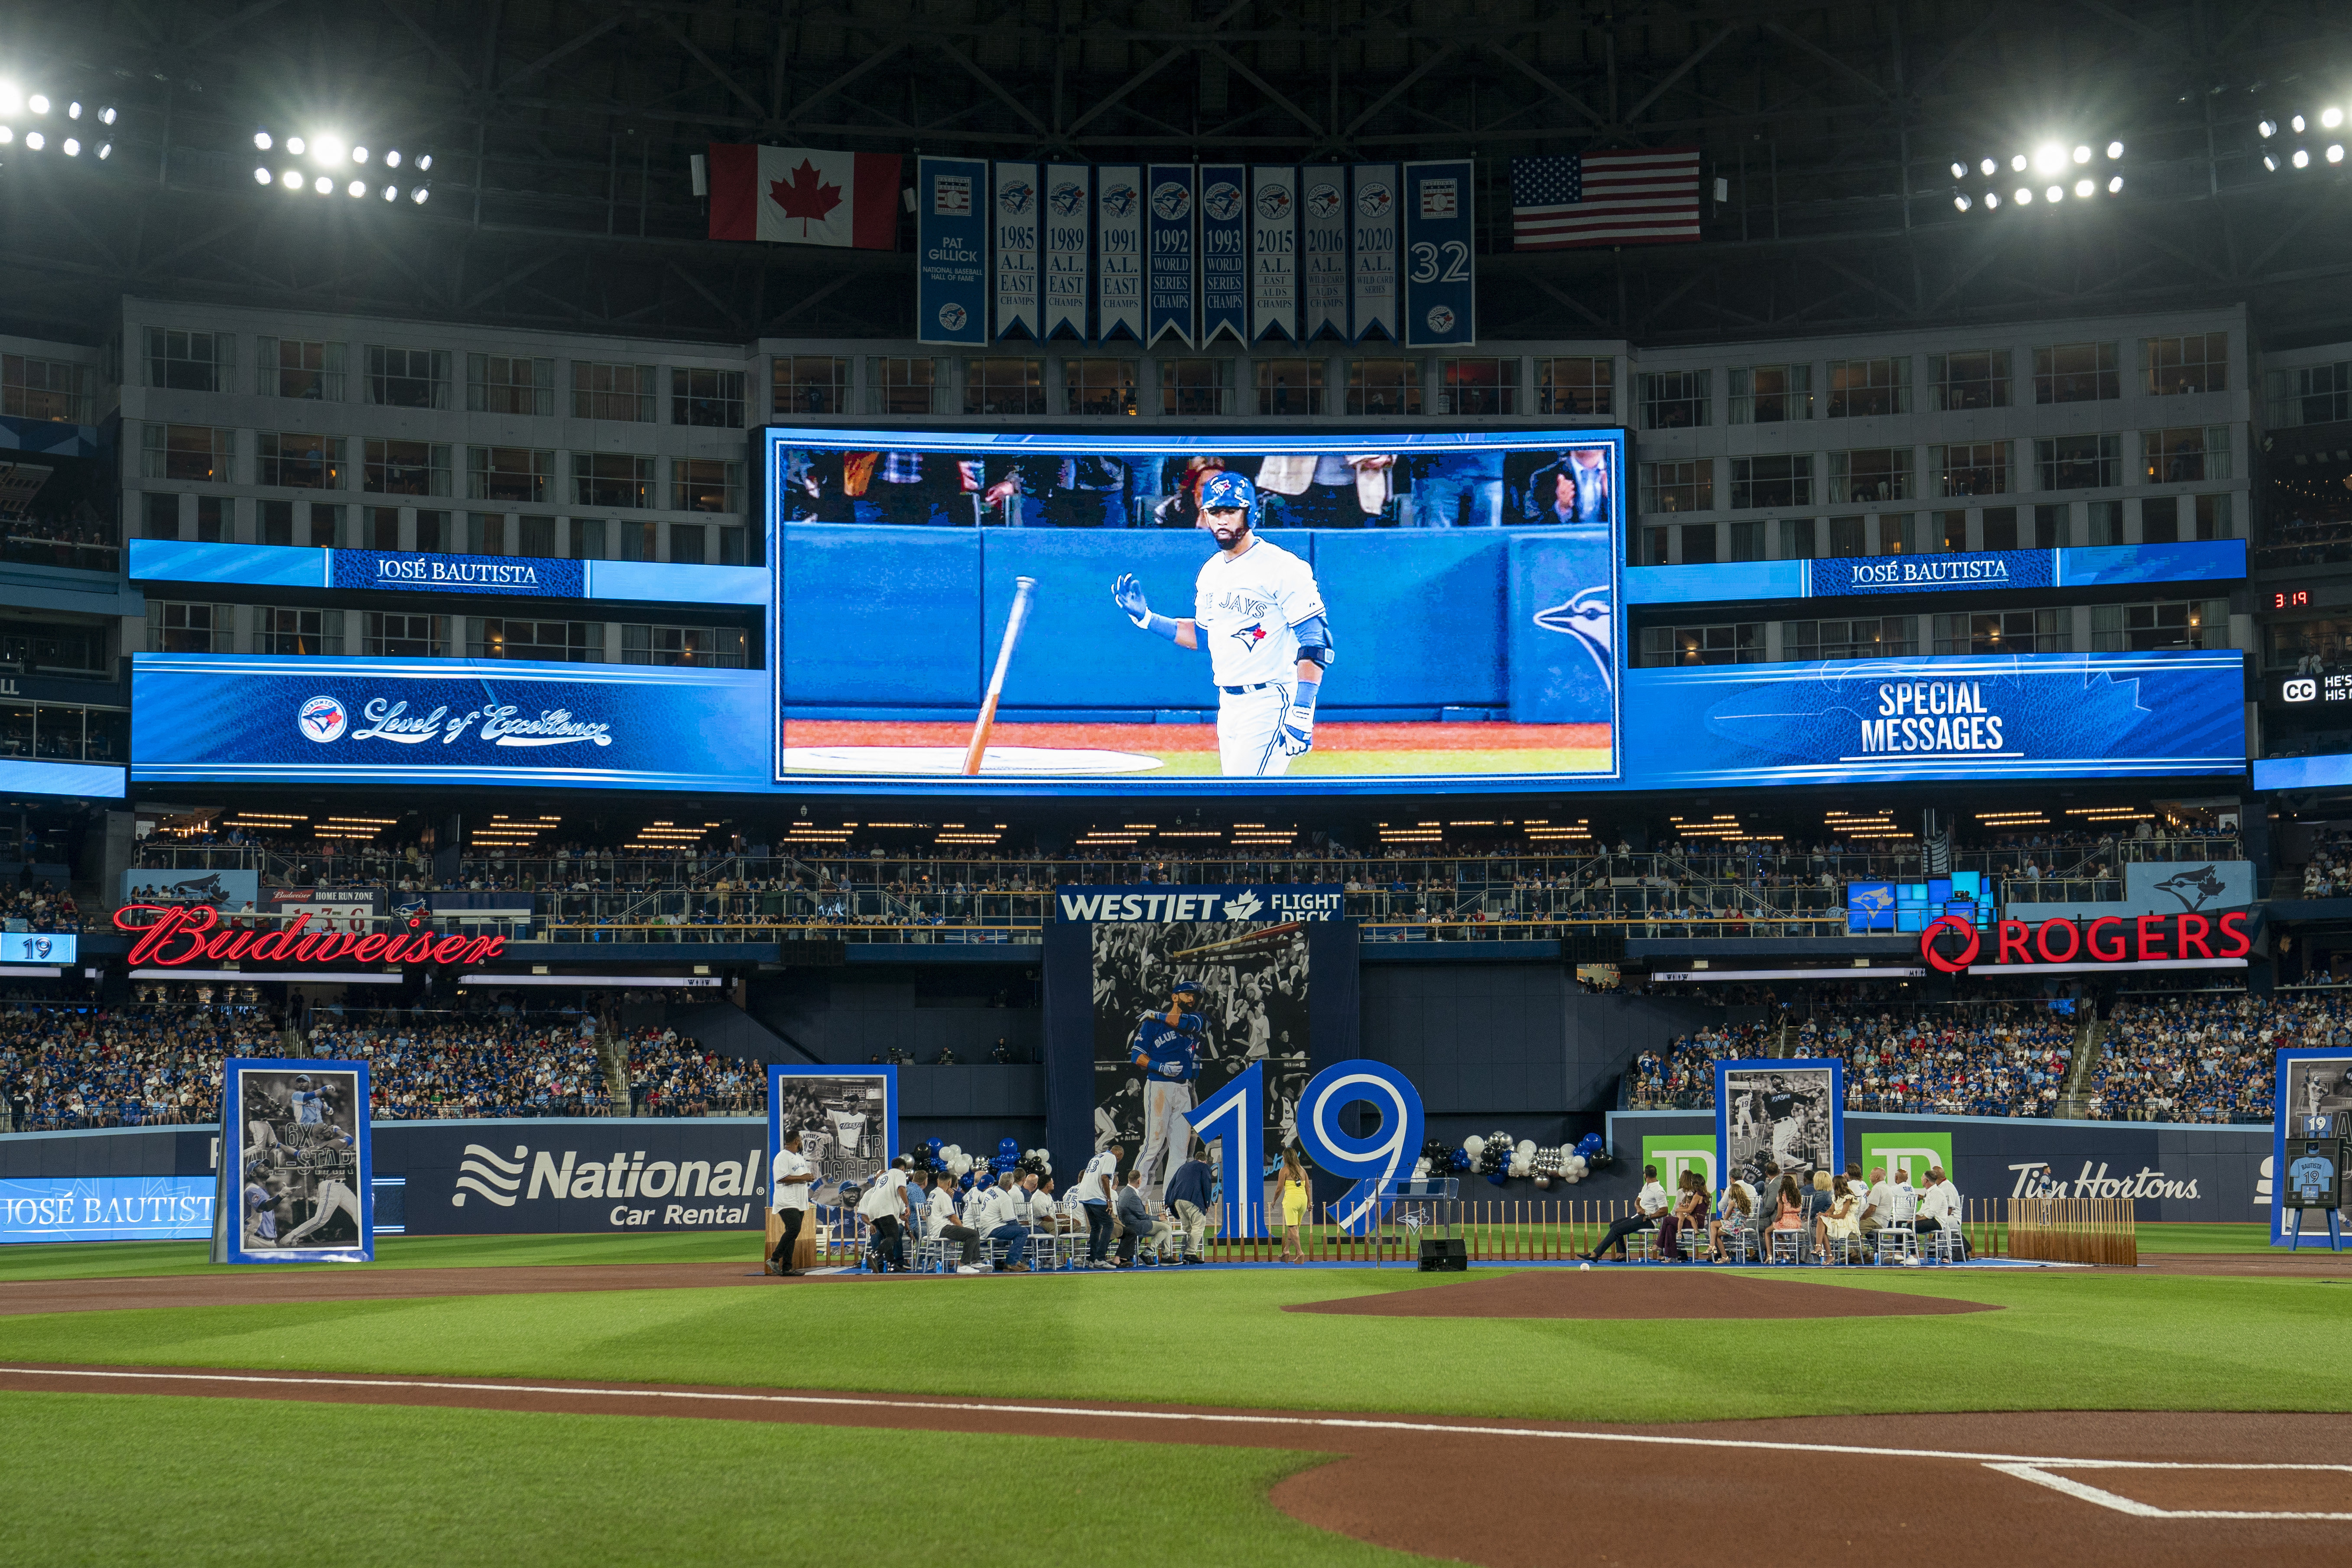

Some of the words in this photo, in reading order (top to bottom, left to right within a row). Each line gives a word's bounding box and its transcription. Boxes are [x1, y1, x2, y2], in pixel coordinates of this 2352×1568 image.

[1259, 187, 1282, 198] TORONTO
[1309, 186, 1332, 198] TORONTO
[1361, 185, 1383, 197] TORONTO
[1260, 206, 1273, 217] BLUE
[1309, 205, 1322, 216] BLUE
[1360, 204, 1373, 215] BLUE
[943, 237, 963, 249] PAT
[1000, 226, 1034, 250] 1985
[1050, 227, 1084, 251] 1989
[1103, 229, 1136, 252] 1991
[1154, 230, 1188, 253] 1992
[1207, 230, 1241, 253] 1993
[1256, 230, 1293, 253] 2015
[1308, 229, 1343, 252] 2016
[1358, 227, 1393, 251] 2020
[929, 249, 977, 262] GILLICK
[1001, 254, 1034, 270] A.L.
[1360, 256, 1390, 271] A.L.
[1410, 240, 1469, 283] 32
[1049, 256, 1083, 272] A.L.
[1104, 257, 1138, 273] A.L.
[1154, 257, 1188, 271] WORLD
[1207, 258, 1241, 271] WORLD
[1259, 257, 1290, 273] A.L.
[1311, 256, 1341, 272] A.L.
[1001, 275, 1034, 292] EAST
[1049, 276, 1083, 294] EAST
[1104, 278, 1138, 295] EAST
[1154, 276, 1188, 290] SERIES
[1208, 276, 1241, 290] SERIES
[1264, 276, 1286, 285] EAST
[1308, 275, 1325, 284] WILD
[1327, 275, 1344, 283] CARD
[1357, 276, 1374, 285] WILD
[1377, 275, 1394, 284] CARD
[1263, 288, 1286, 296] ALDS
[1315, 287, 1338, 296] ALDS
[1365, 285, 1385, 294] SERIES
[1000, 296, 1034, 305] CHAMPS
[1049, 297, 1083, 307] CHAMPS
[1103, 299, 1138, 308] CHAMPS
[1153, 295, 1188, 308] CHAMPS
[1207, 295, 1242, 308] CHAMPS
[1257, 299, 1292, 308] CHAMPS
[1310, 299, 1344, 308] CHAMPS
[377, 558, 427, 579] JOSÉ
[432, 563, 537, 584] BAUTISTA
[1852, 561, 1899, 583] JOSÉ
[1904, 560, 2009, 581] BAUTISTA
[1218, 592, 1267, 618] JAYS
[2325, 675, 2352, 688] HE'S
[1878, 682, 1987, 716] SPECIAL
[2287, 683, 2313, 699] CC
[2325, 689, 2346, 701] HIS
[304, 701, 332, 714] TORONTO
[352, 698, 447, 744] Level
[443, 711, 480, 744] of
[480, 704, 612, 746] Excellence
[1861, 716, 2003, 752] MESSAGES
[273, 891, 311, 899] Budweiser
[354, 892, 374, 900] ZONE
[1061, 894, 1221, 923] WESTJET
[1272, 894, 1341, 909] FLIGHT
[114, 904, 506, 964] Budweiser
[1999, 912, 2251, 964] ROGERS
[23, 937, 51, 959] 19
[1154, 1031, 1177, 1048] BLUE
[2308, 1117, 2326, 1130] 19
[285, 1122, 314, 1148] 6X
[1733, 1124, 1773, 1160] 54
[815, 1135, 884, 1159] SILVER
[1182, 1059, 1425, 1238] 19
[1085, 1159, 1099, 1173] 43
[1871, 1148, 1943, 1195] TD
[527, 1150, 761, 1199] National
[2075, 1161, 2198, 1199] Hortons
[2303, 1171, 2319, 1184] 19
[5, 1192, 75, 1225] JOSÉ
[610, 1205, 655, 1226] Car
[664, 1203, 750, 1224] Rental
